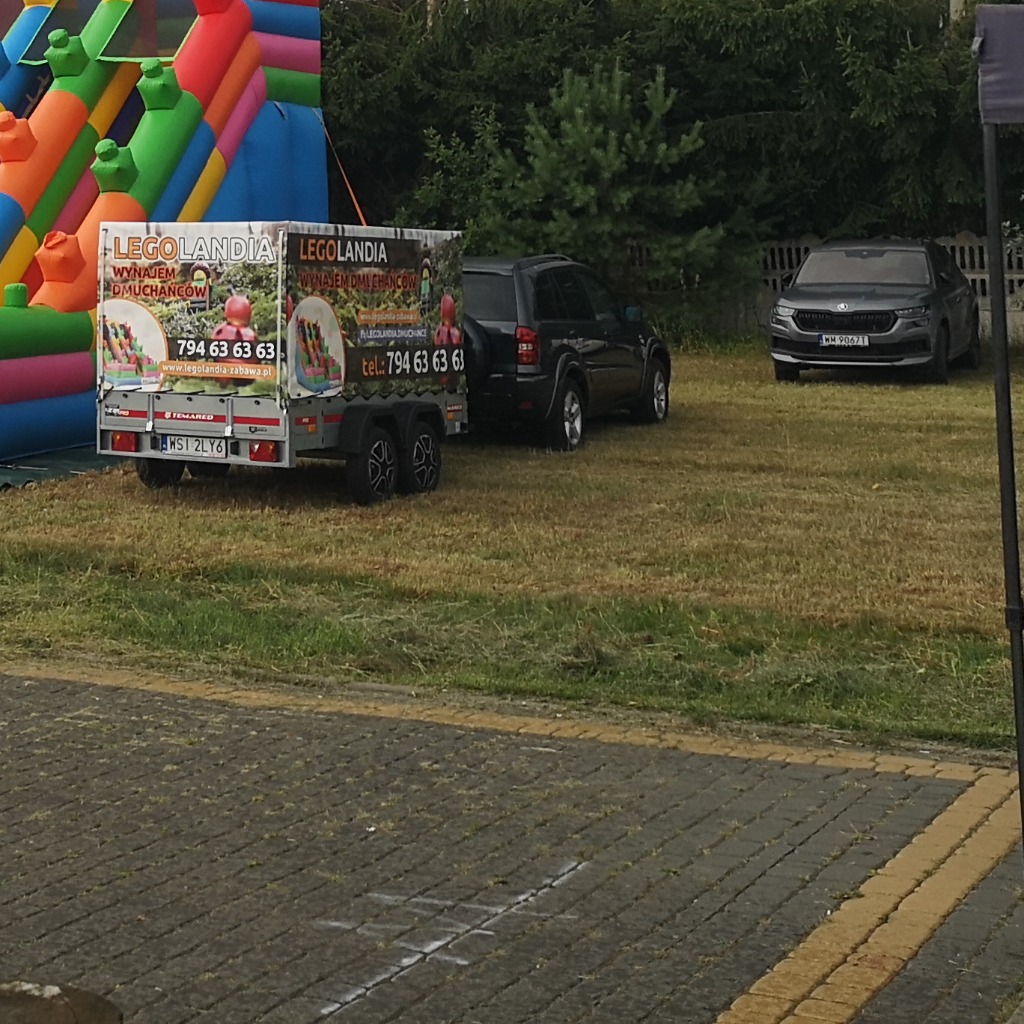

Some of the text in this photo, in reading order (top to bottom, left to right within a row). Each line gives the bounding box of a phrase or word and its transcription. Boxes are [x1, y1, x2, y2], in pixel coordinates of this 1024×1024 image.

[113, 236, 275, 262] LEGOLANDIA
[299, 238, 388, 263] LEGOLANDIA
[112, 266, 176, 280] WYNAJEM
[177, 339, 275, 360] 794 63 63 63
[386, 350, 410, 375] 794
[413, 349, 429, 374] 63
[432, 349, 448, 372] 63
[452, 348, 465, 371] 63
[169, 437, 224, 453] WSI 2LY6
